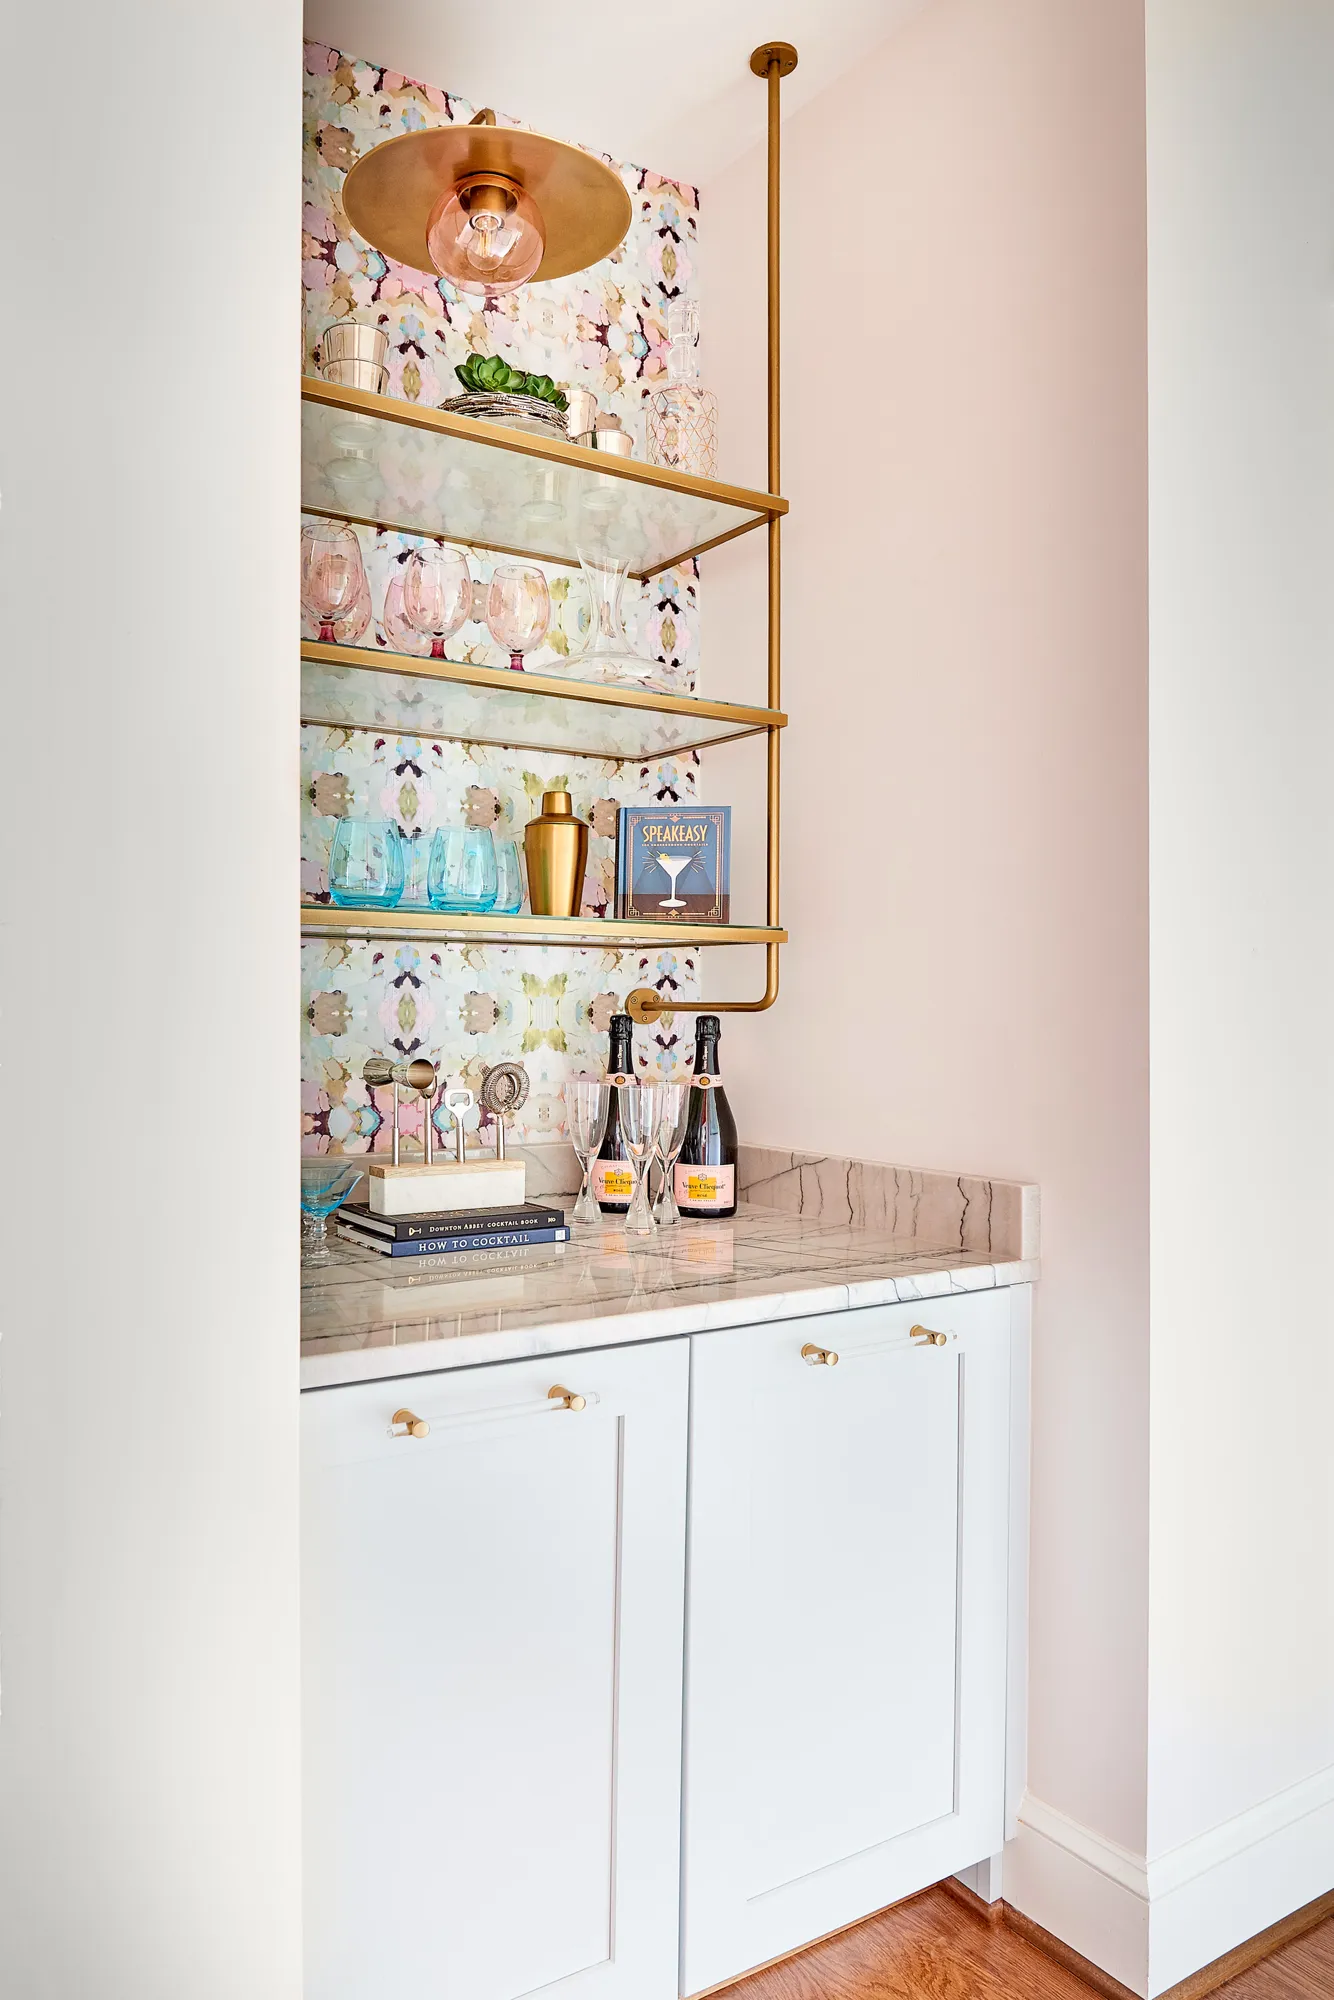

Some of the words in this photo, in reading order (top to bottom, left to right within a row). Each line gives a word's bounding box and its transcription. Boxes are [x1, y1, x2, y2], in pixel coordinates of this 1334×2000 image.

[642, 824, 708, 842] SPEAKEASY
[429, 1225, 462, 1233] DOWNTON
[487, 1219, 519, 1228] COCKTAIL
[418, 1241, 447, 1252] HOW
[451, 1239, 468, 1249] TO
[472, 1234, 530, 1247] COCKTAIL
